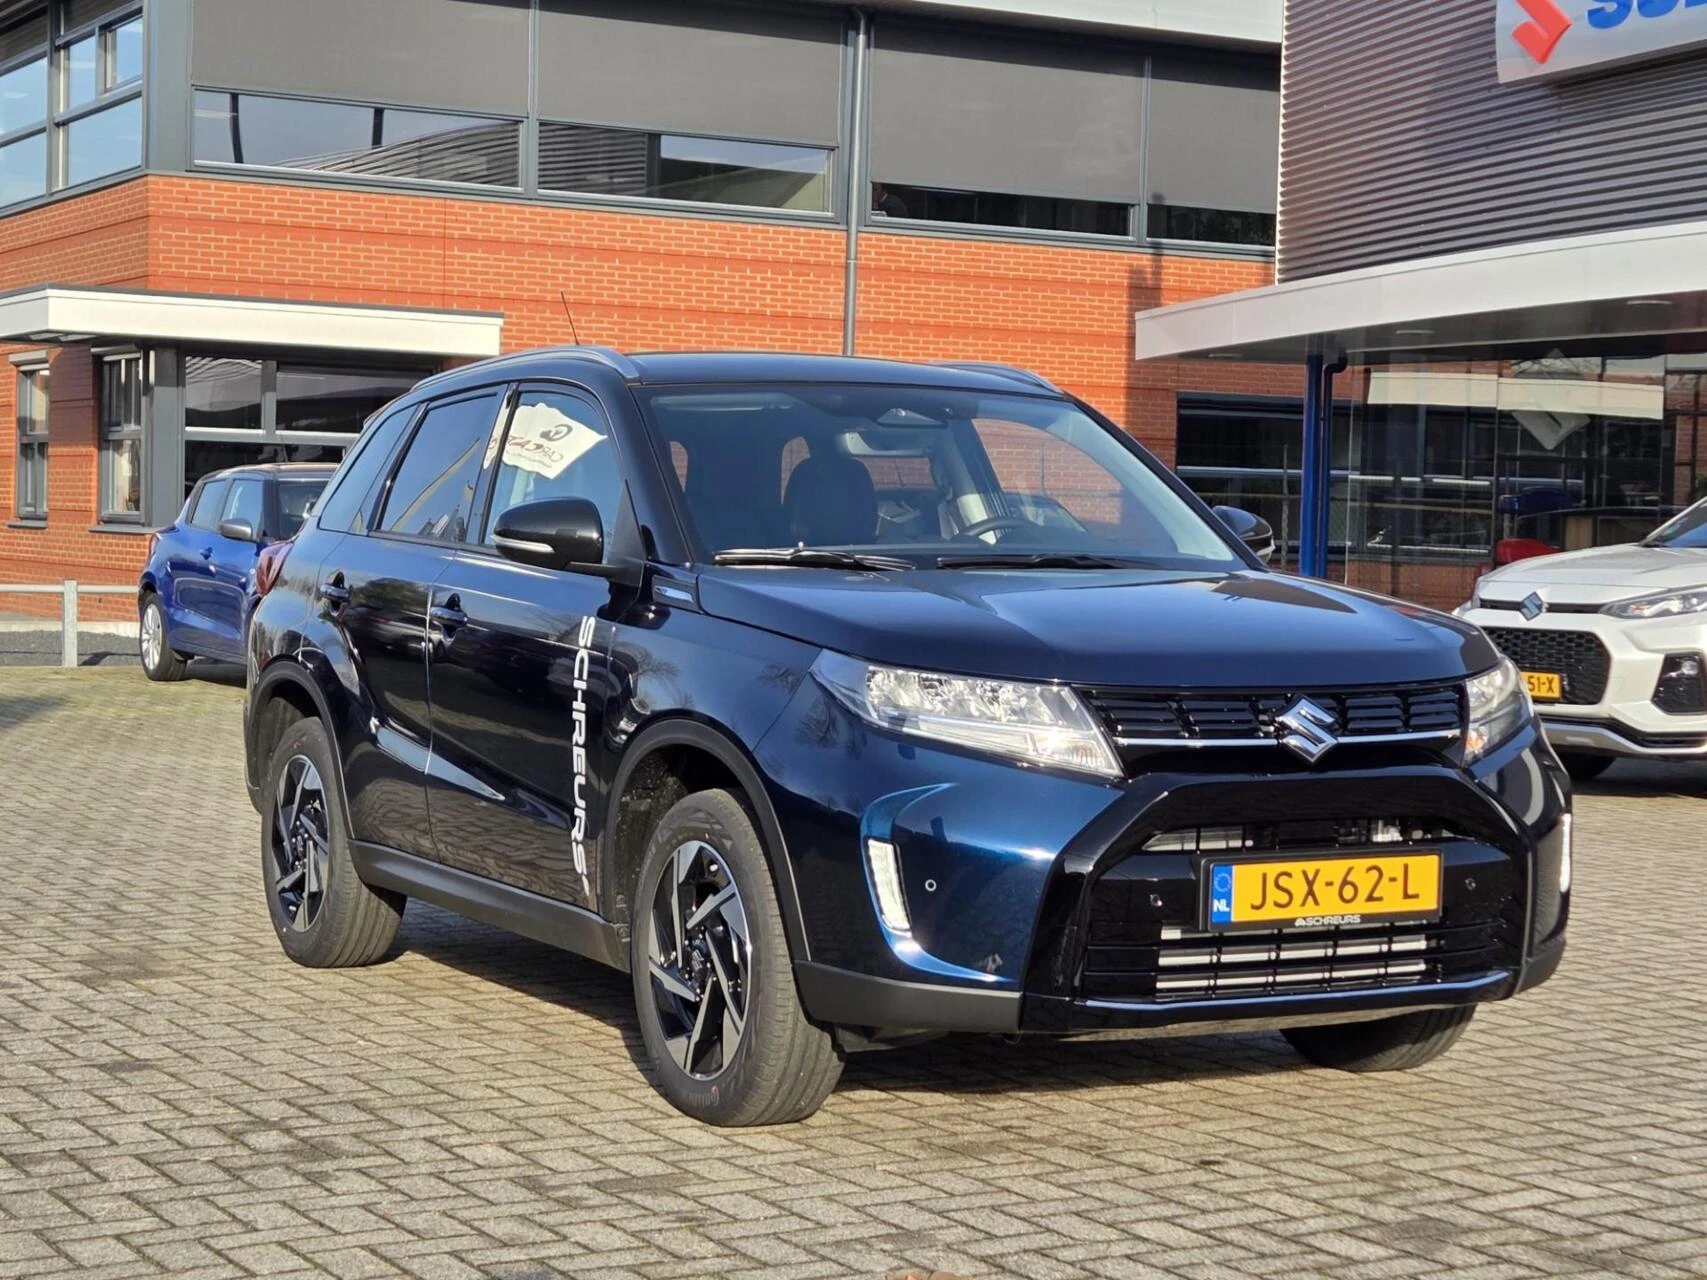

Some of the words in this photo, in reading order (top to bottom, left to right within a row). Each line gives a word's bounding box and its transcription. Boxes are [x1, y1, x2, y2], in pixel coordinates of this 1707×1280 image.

[1527, 675, 1555, 694] 51-X
[571, 615, 596, 875] SCHREURS
[1250, 863, 1420, 911] JSX-62-L
[1213, 899, 1231, 913] NL
[1305, 915, 1362, 927] SCHREURS
